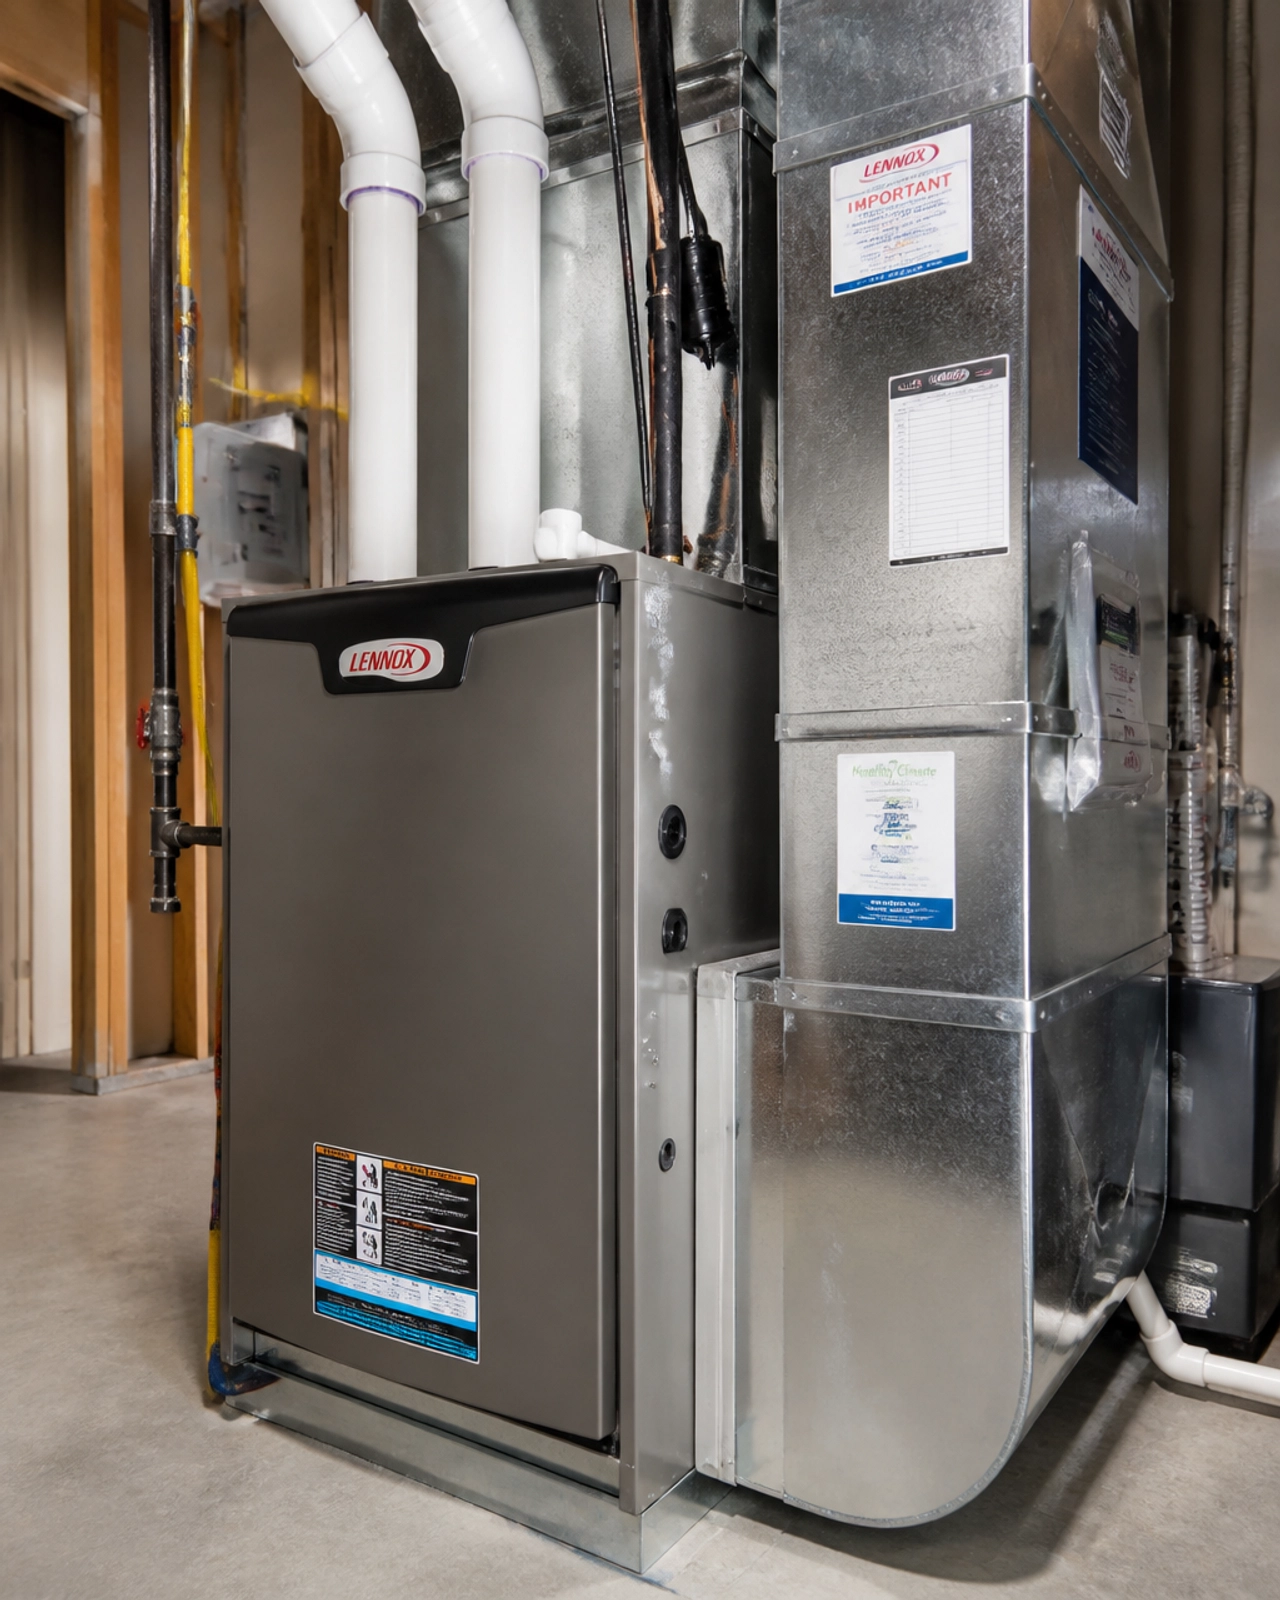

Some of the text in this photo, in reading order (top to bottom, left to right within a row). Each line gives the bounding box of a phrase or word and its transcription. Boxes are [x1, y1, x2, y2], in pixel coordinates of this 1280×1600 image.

[864, 147, 926, 178] LENNOX
[848, 172, 952, 214] IMPORTANT
[349, 648, 416, 672] LENNOX
